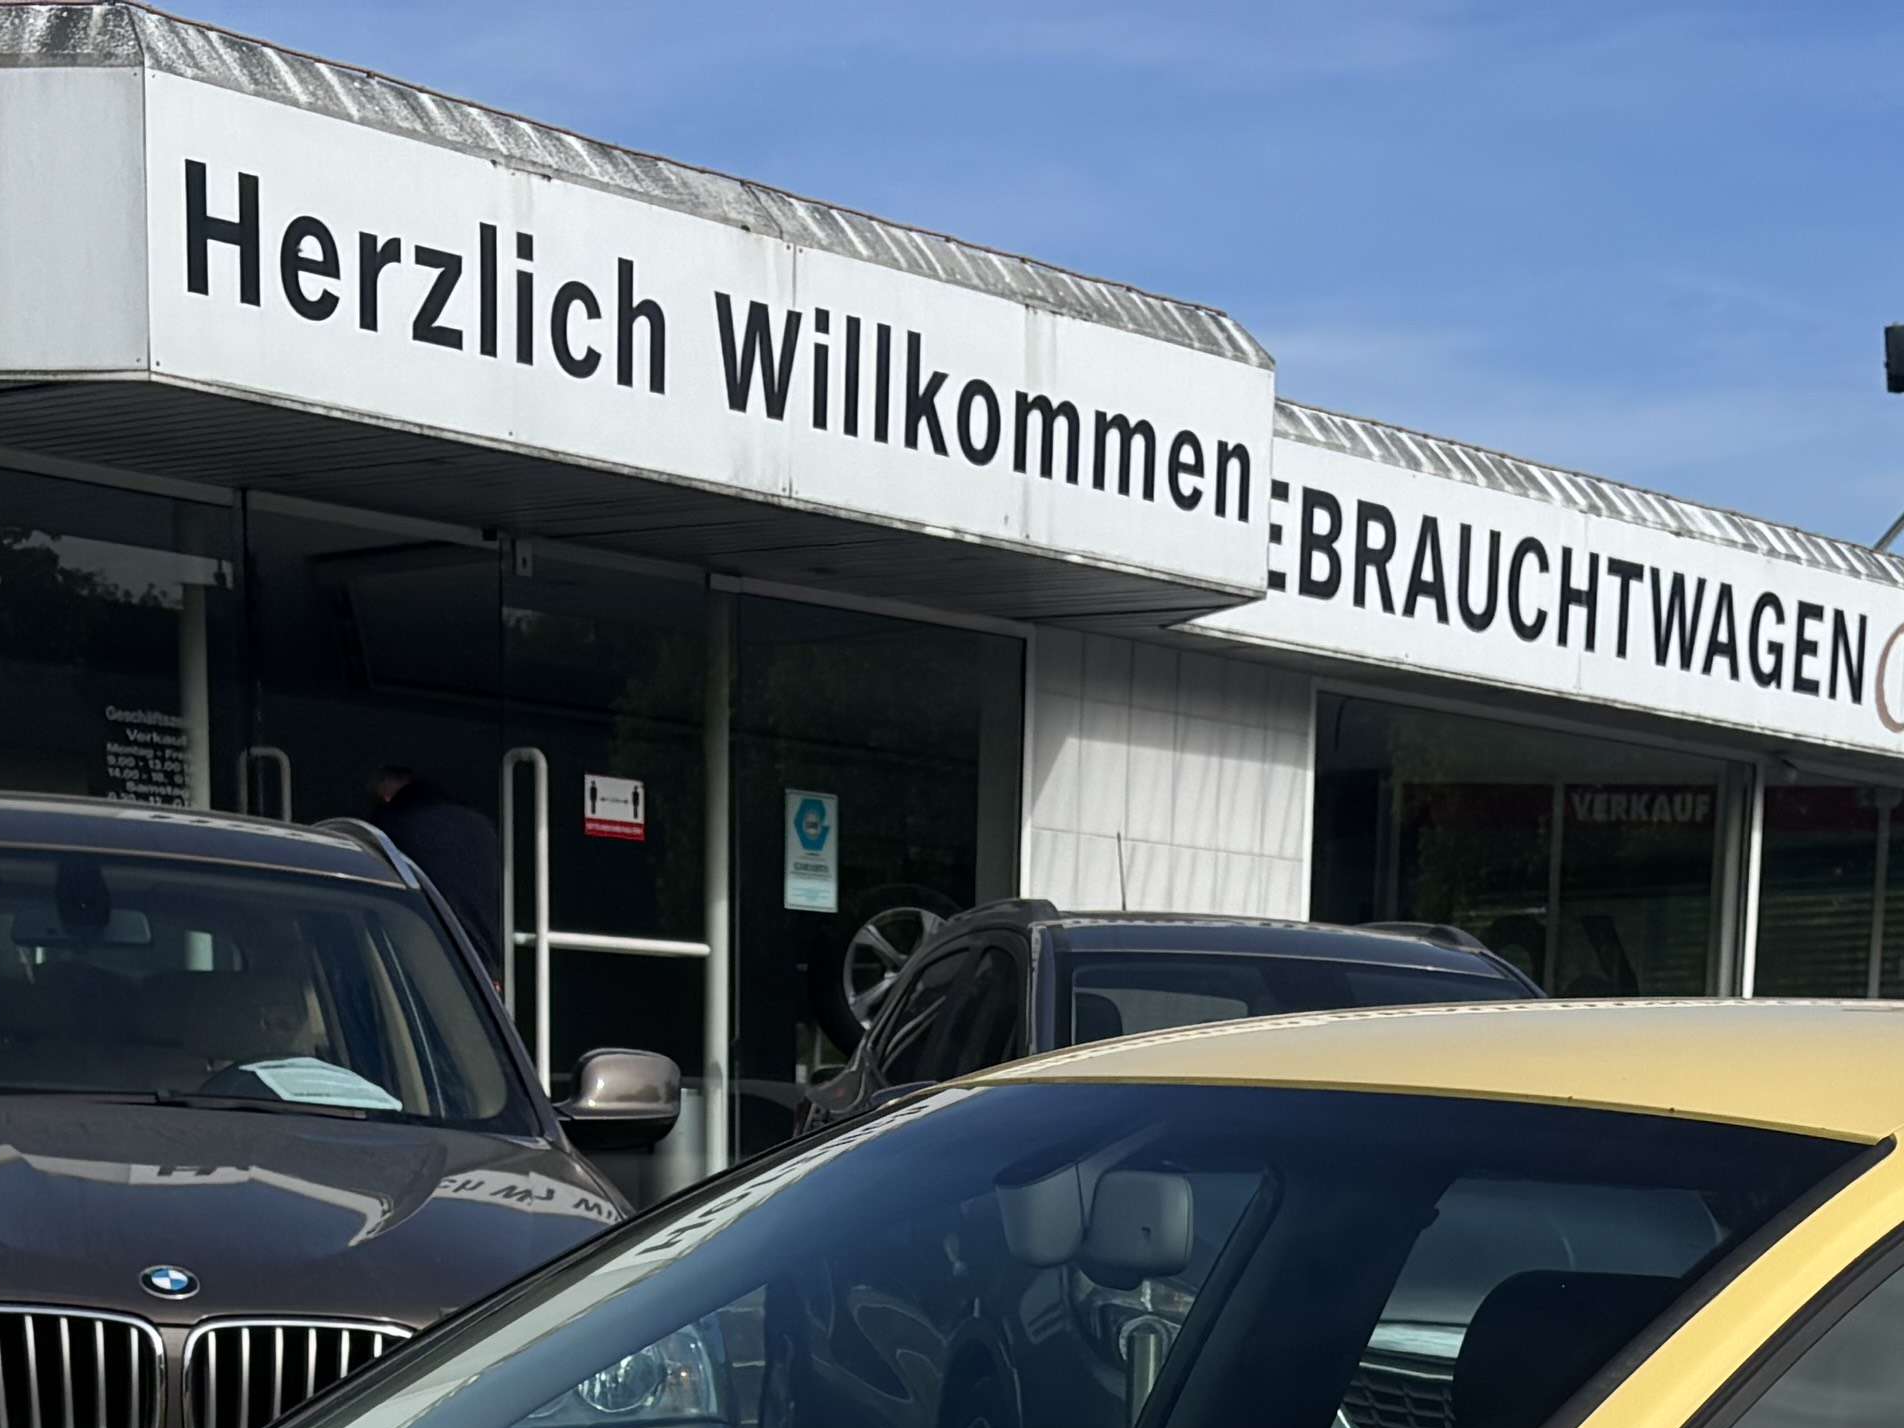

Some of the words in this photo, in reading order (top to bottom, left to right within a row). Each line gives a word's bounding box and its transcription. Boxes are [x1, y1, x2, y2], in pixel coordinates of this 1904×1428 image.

[184, 158, 669, 396] Herzlich
[715, 291, 1253, 524] Willkommen
[1570, 791, 1712, 823] VERKAUF
